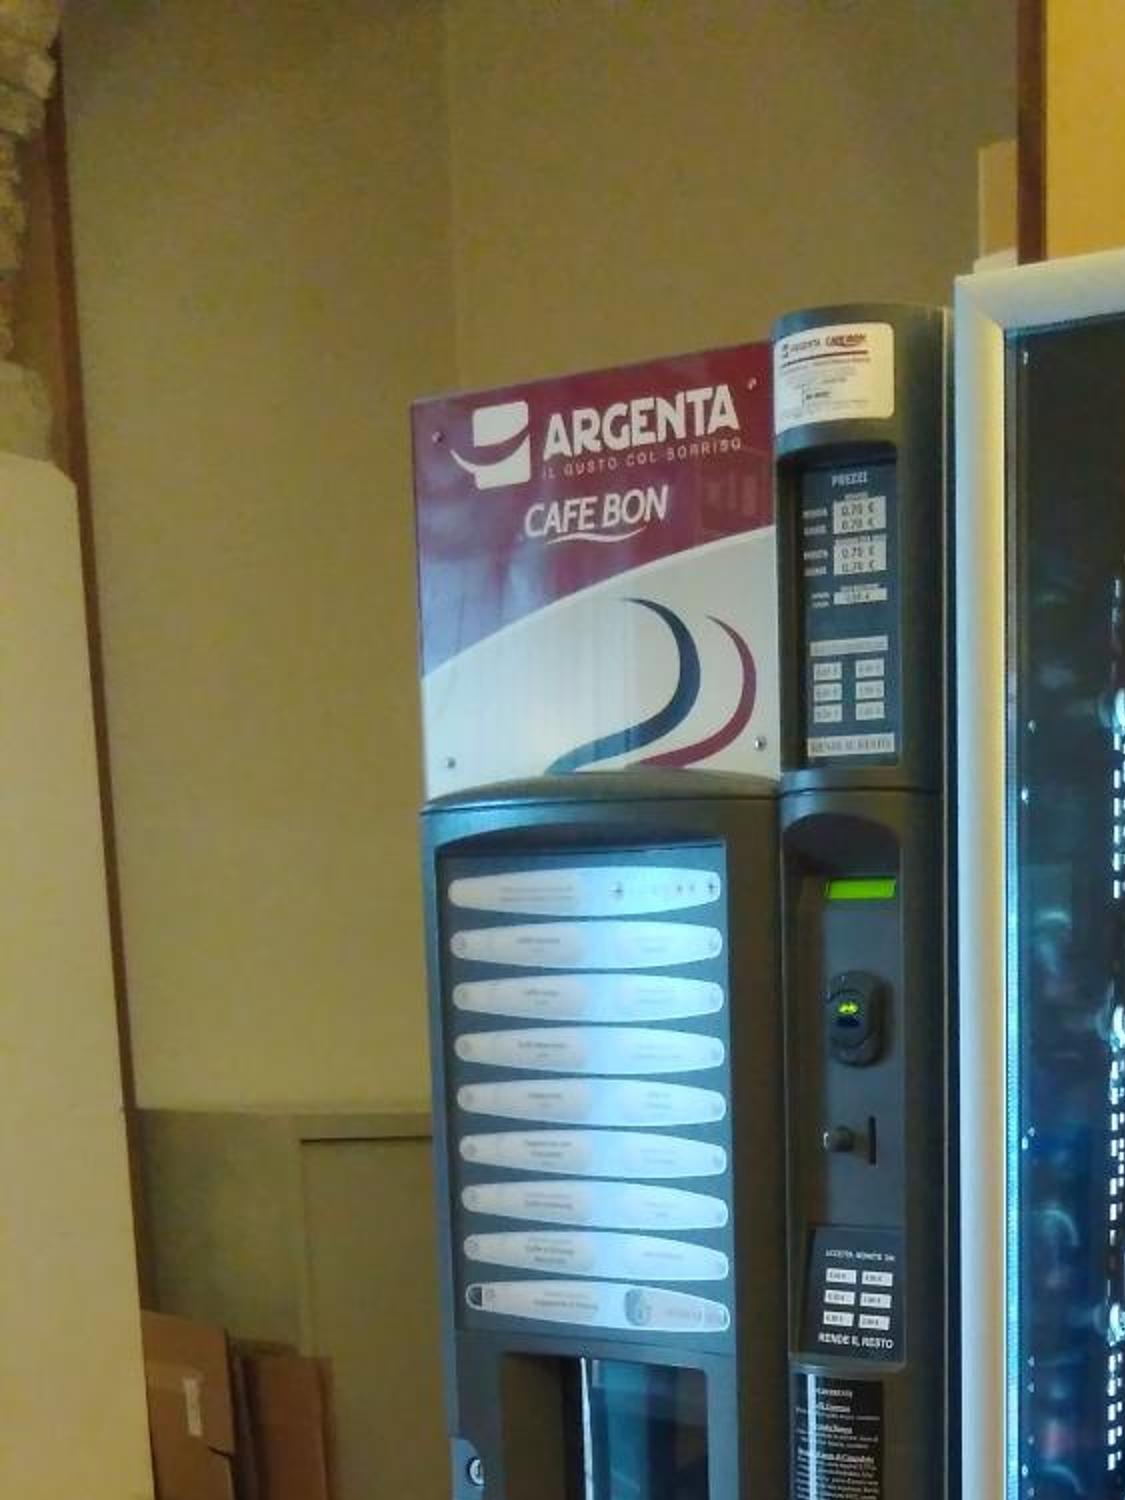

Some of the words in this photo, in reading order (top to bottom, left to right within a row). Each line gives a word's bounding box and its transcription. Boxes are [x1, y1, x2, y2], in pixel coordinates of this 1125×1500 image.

[543, 384, 740, 462] ARGENTA
[564, 456, 618, 477] GUSTO
[626, 452, 657, 467] COL
[666, 437, 742, 461] SORRISO
[524, 496, 599, 538] CAFE
[602, 485, 669, 528] BON
